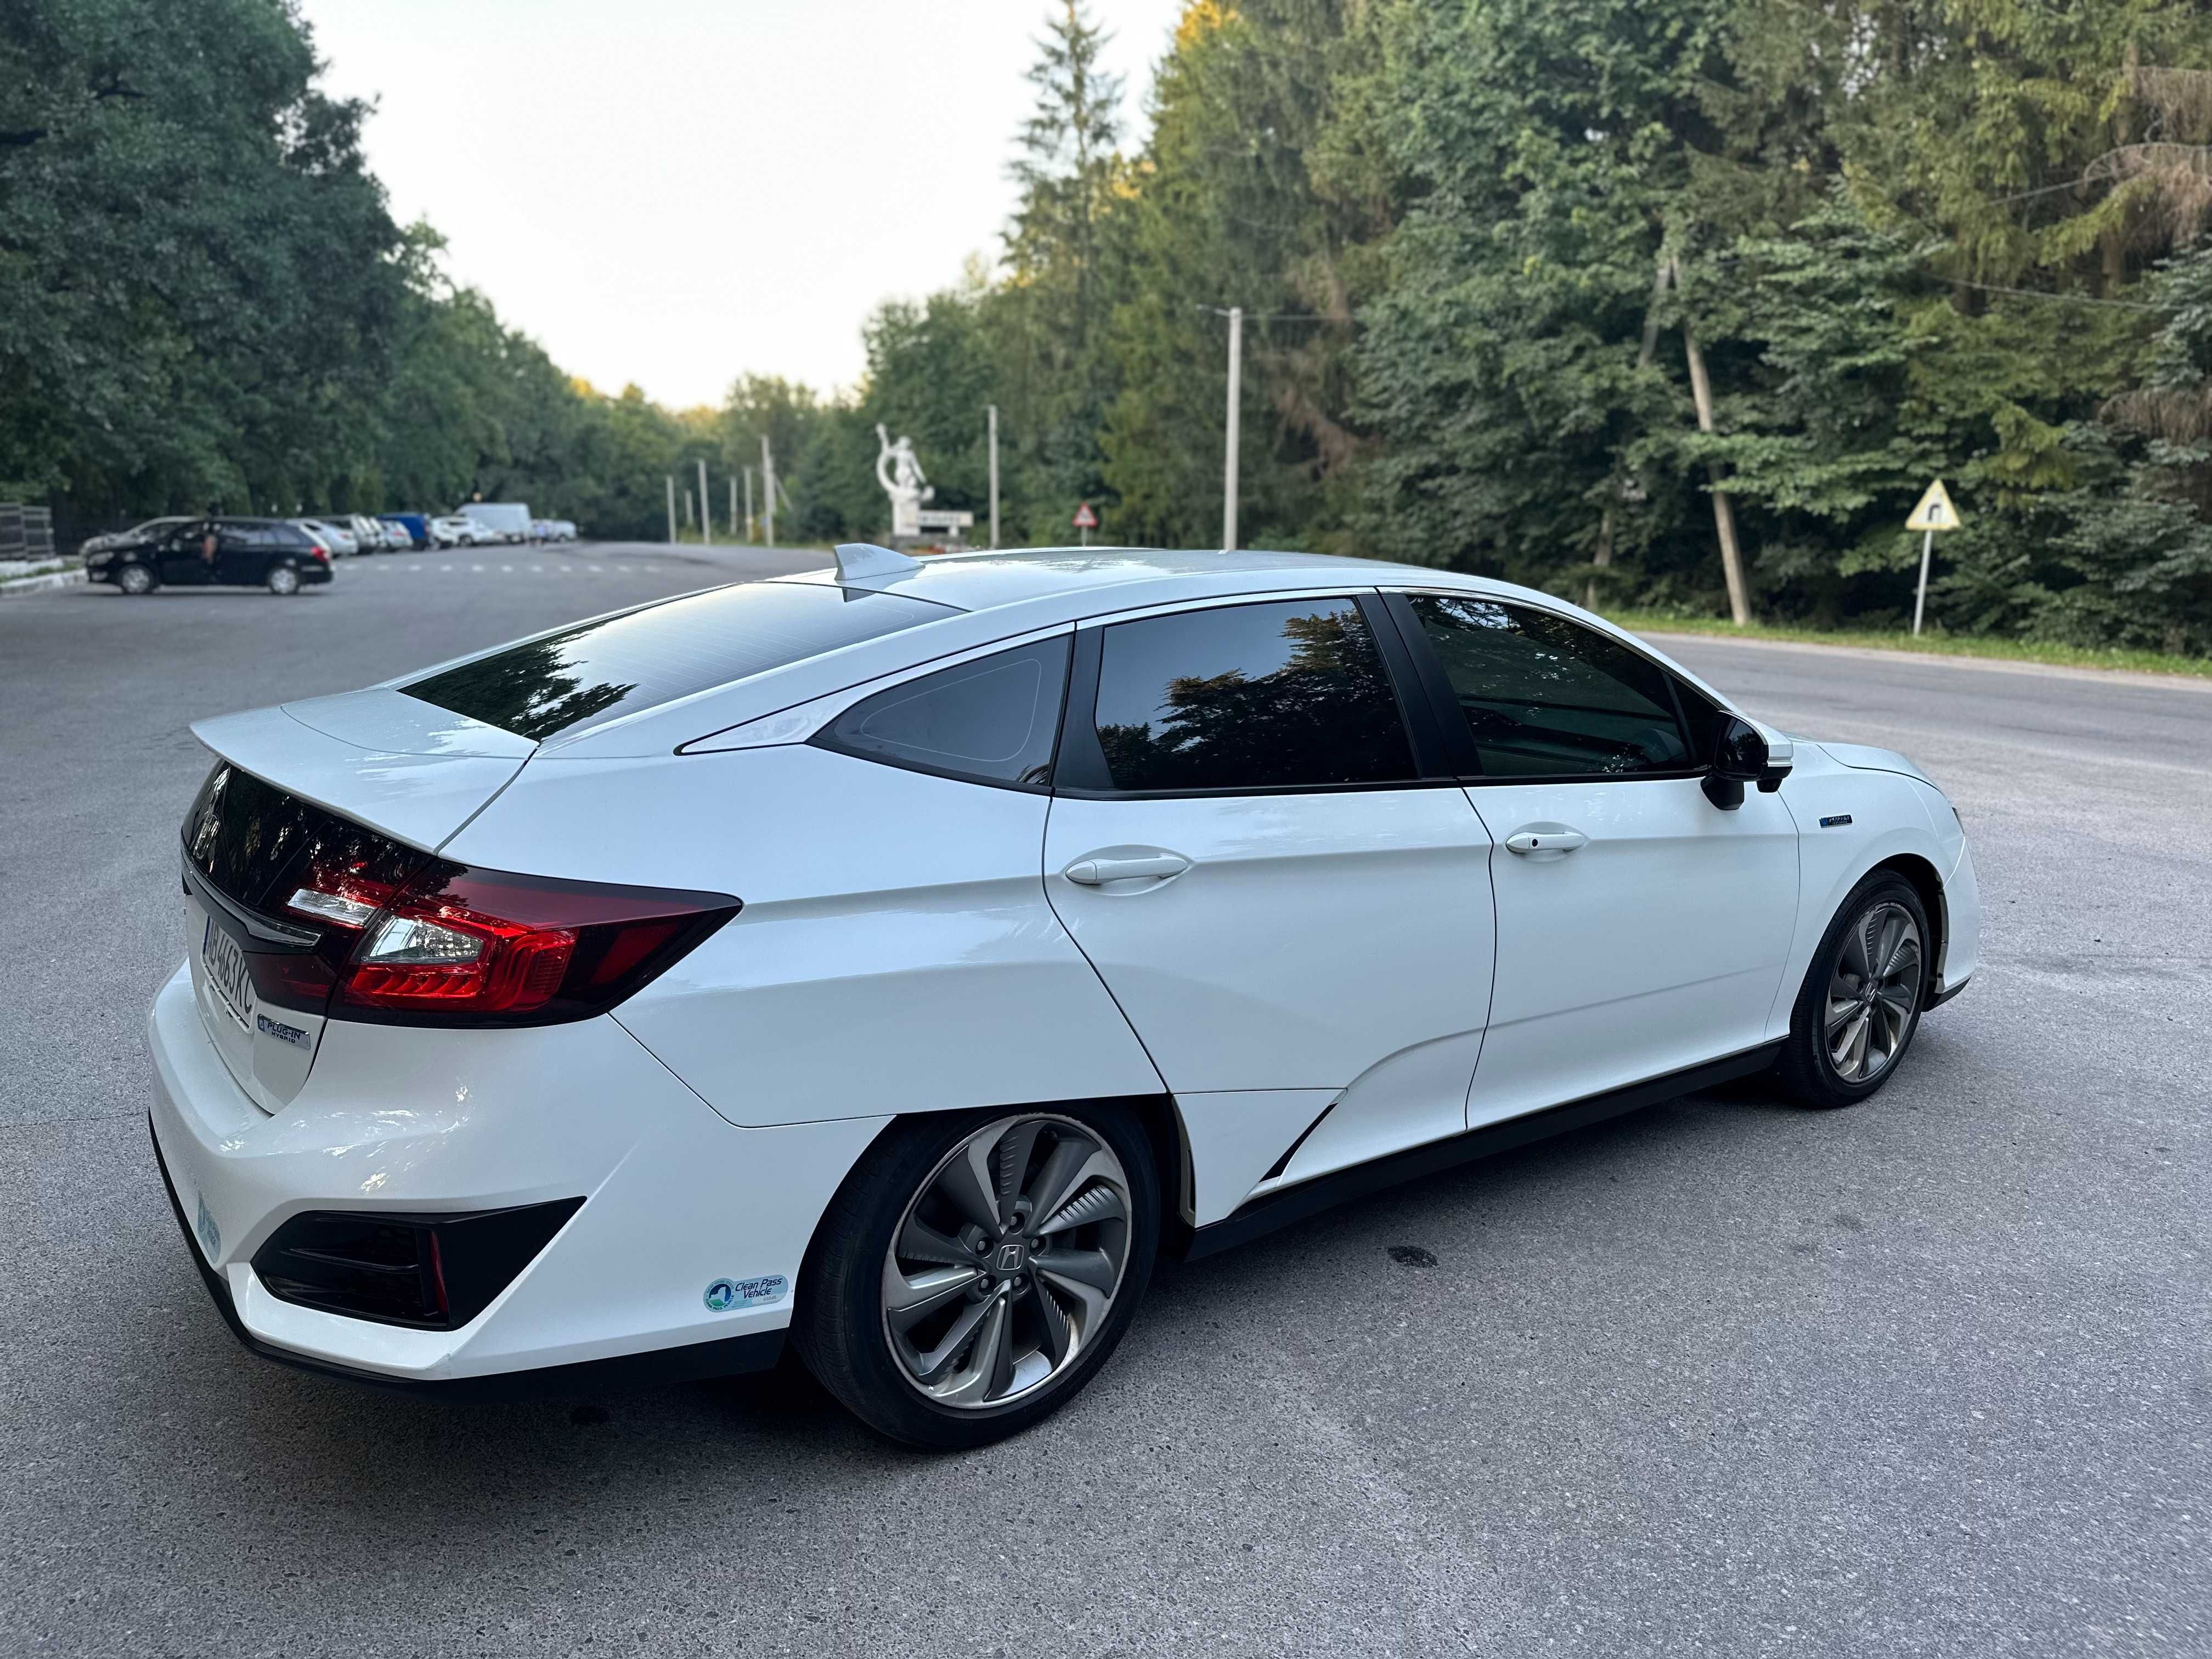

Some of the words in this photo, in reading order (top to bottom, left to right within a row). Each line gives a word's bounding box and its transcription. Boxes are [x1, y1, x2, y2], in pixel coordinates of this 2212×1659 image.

[267, 1022, 301, 1040] PLUG-IN
[272, 1031, 296, 1043] HYBRID
[735, 1282, 759, 1291] Clean
[760, 1278, 782, 1288] Pass
[743, 1287, 772, 1299] Vehicle
